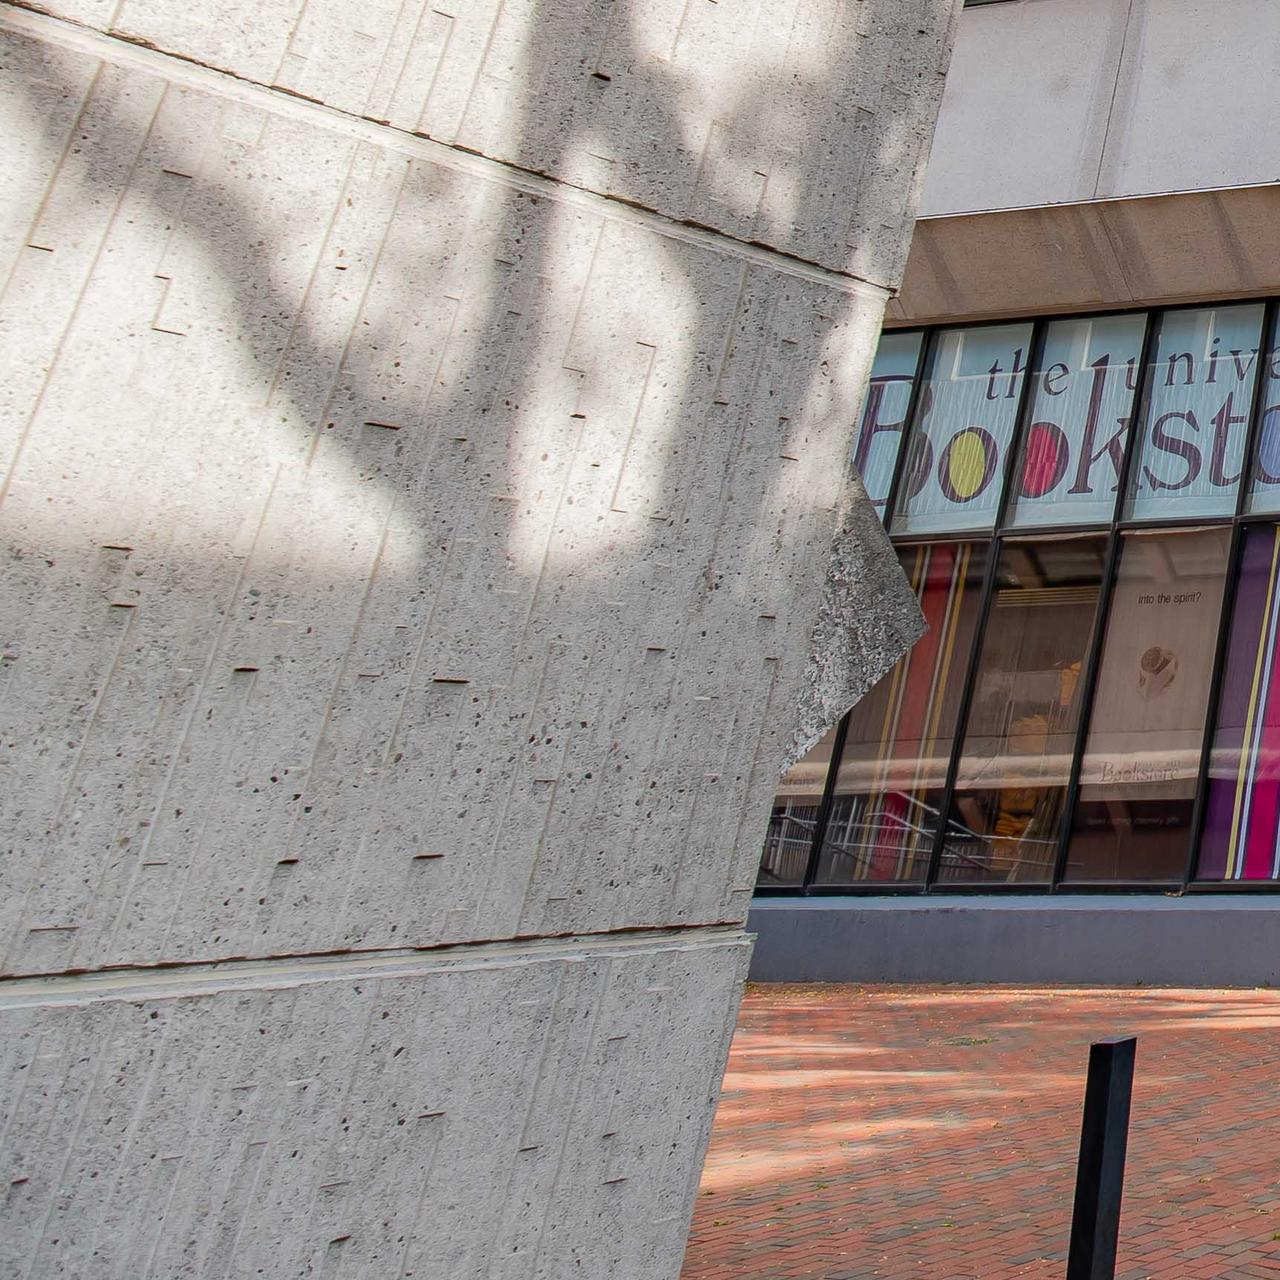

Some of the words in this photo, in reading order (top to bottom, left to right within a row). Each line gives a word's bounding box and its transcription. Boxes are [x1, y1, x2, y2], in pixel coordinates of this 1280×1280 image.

[986, 347, 1070, 402] the
[1138, 594, 1155, 604] into
[1157, 592, 1172, 604] the
[1173, 591, 1202, 605] spirit?
